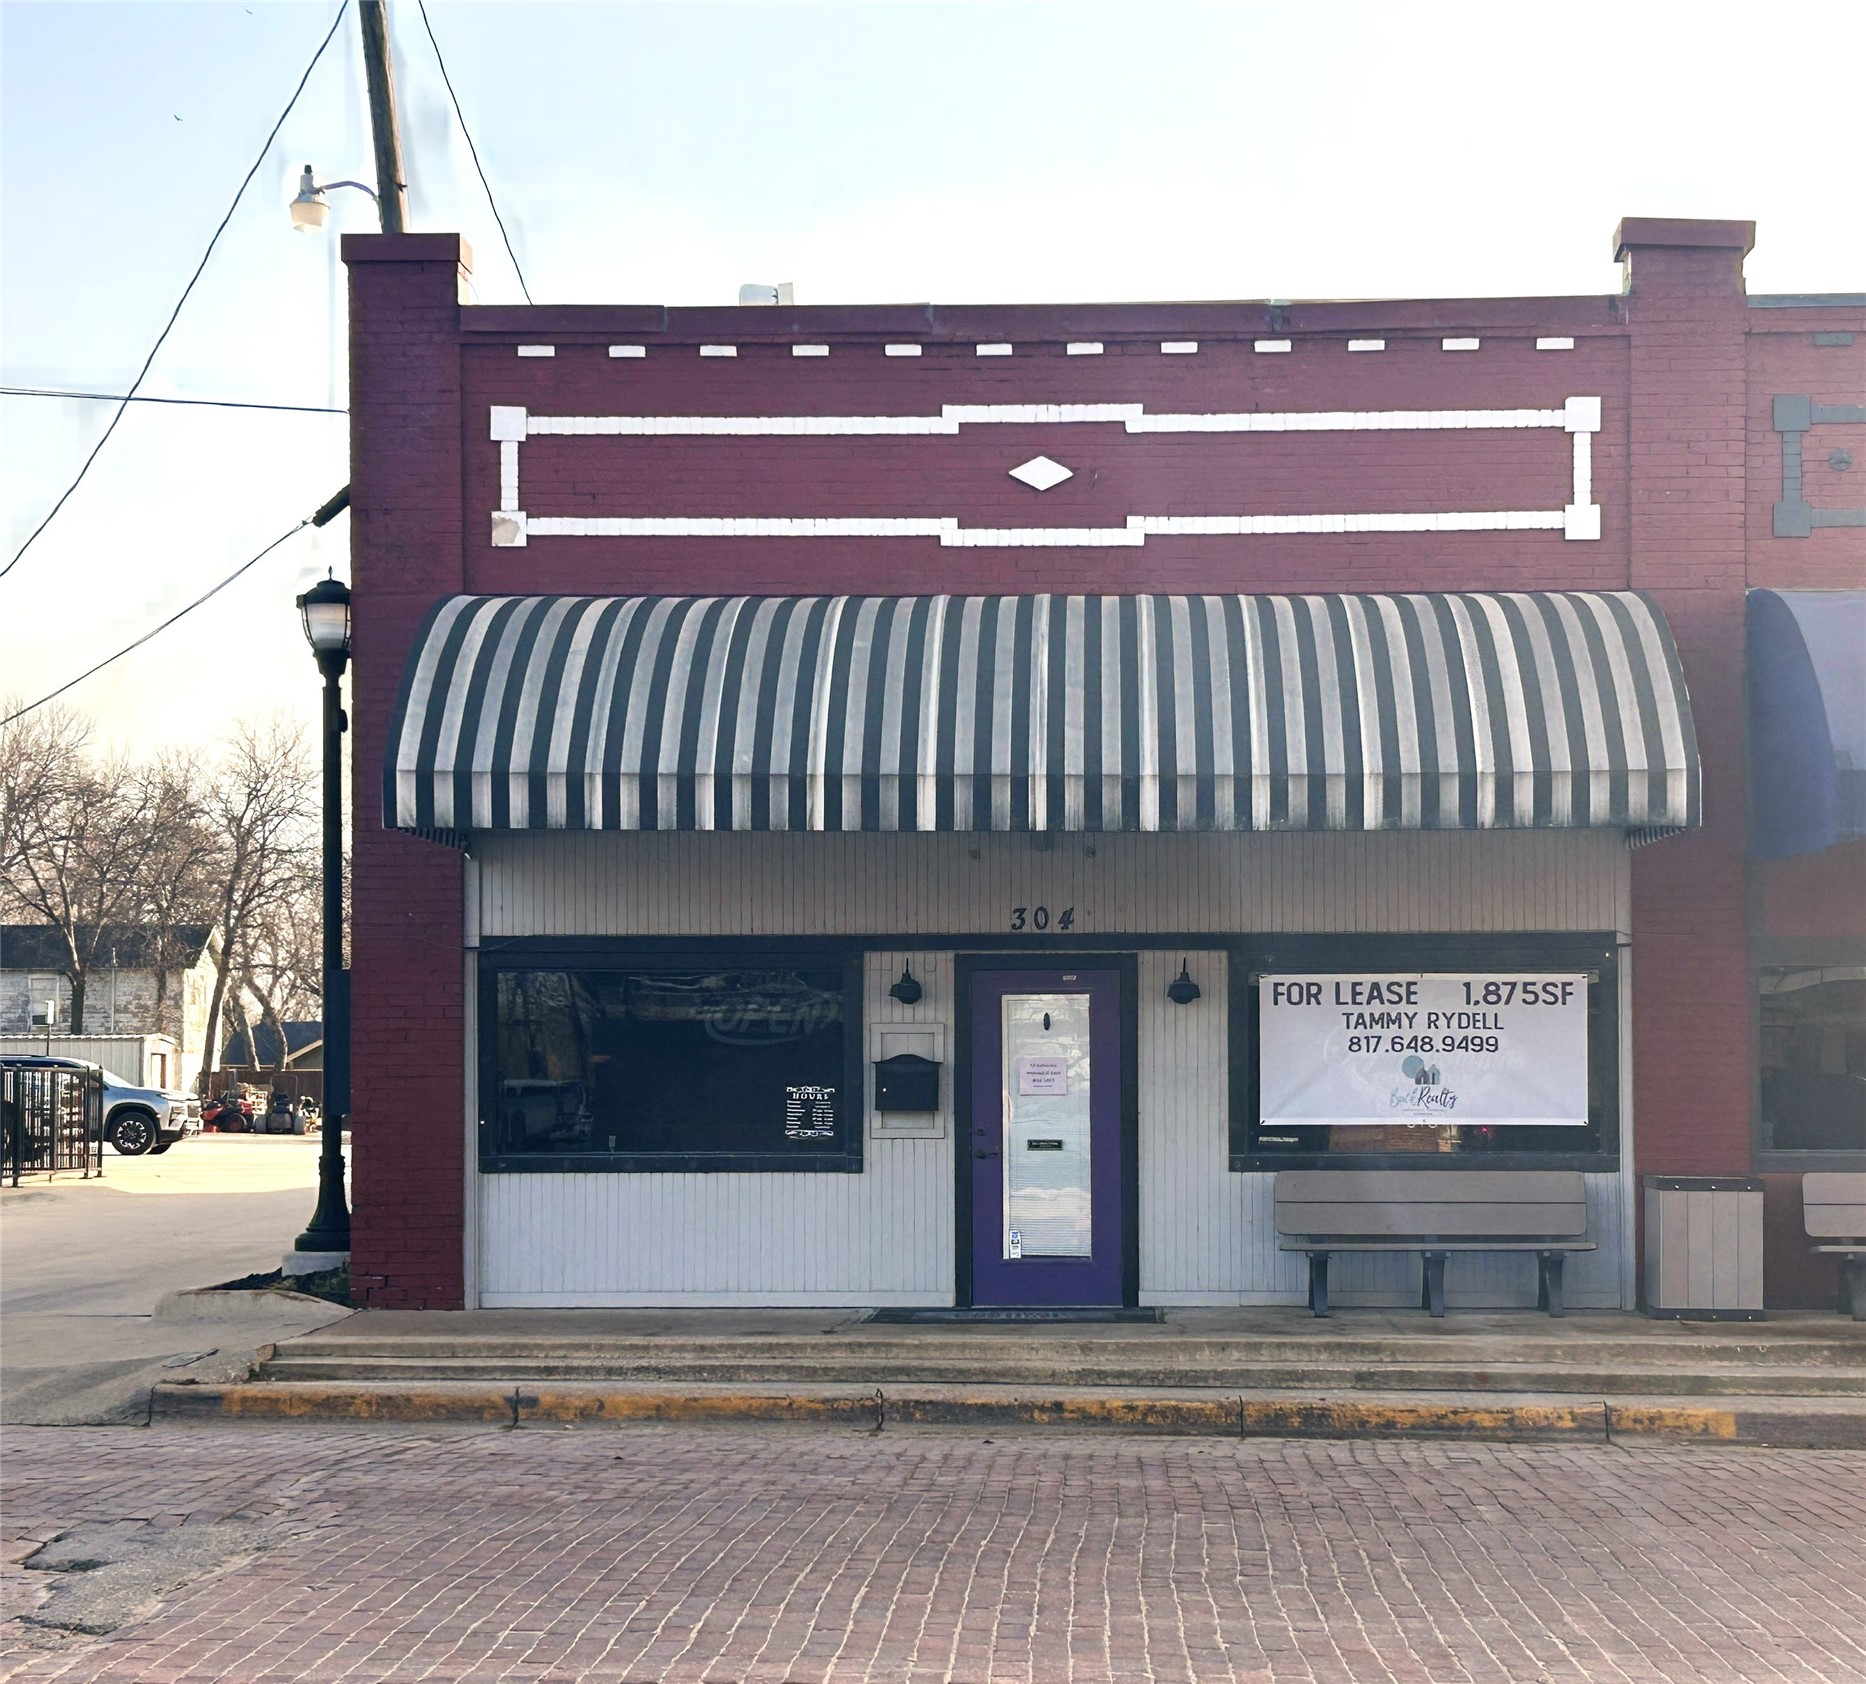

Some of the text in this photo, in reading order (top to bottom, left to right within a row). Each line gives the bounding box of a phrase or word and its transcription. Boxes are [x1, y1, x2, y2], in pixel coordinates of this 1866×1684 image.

[1011, 906, 1075, 931] 304
[1272, 981, 1323, 1006] FOR
[1334, 981, 1419, 1006] LEASE
[1341, 1011, 1505, 1030] TAMMY RYDELL
[1347, 1035, 1499, 1053] 817.648.9499
[792, 1092, 829, 1100] HOURS
